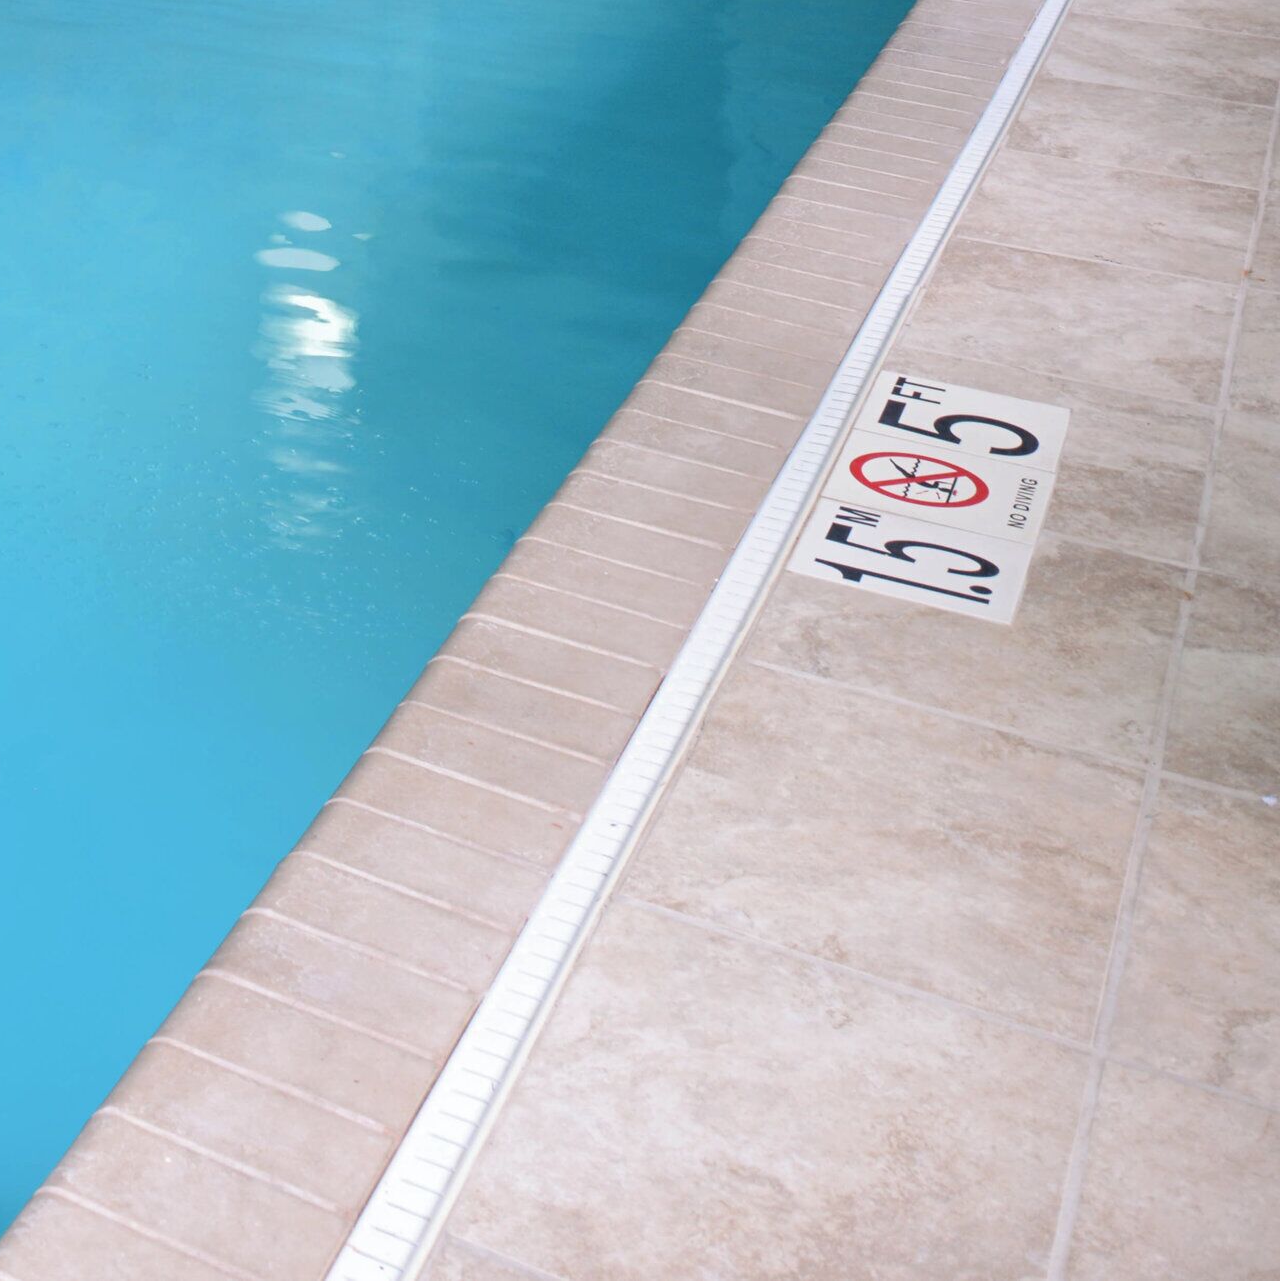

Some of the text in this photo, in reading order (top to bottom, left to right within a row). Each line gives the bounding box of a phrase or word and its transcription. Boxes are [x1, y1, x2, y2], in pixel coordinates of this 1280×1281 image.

[877, 376, 1040, 457] 5 FT
[1007, 477, 1038, 530] NO DIVING
[814, 506, 1000, 605] 1.5 M
